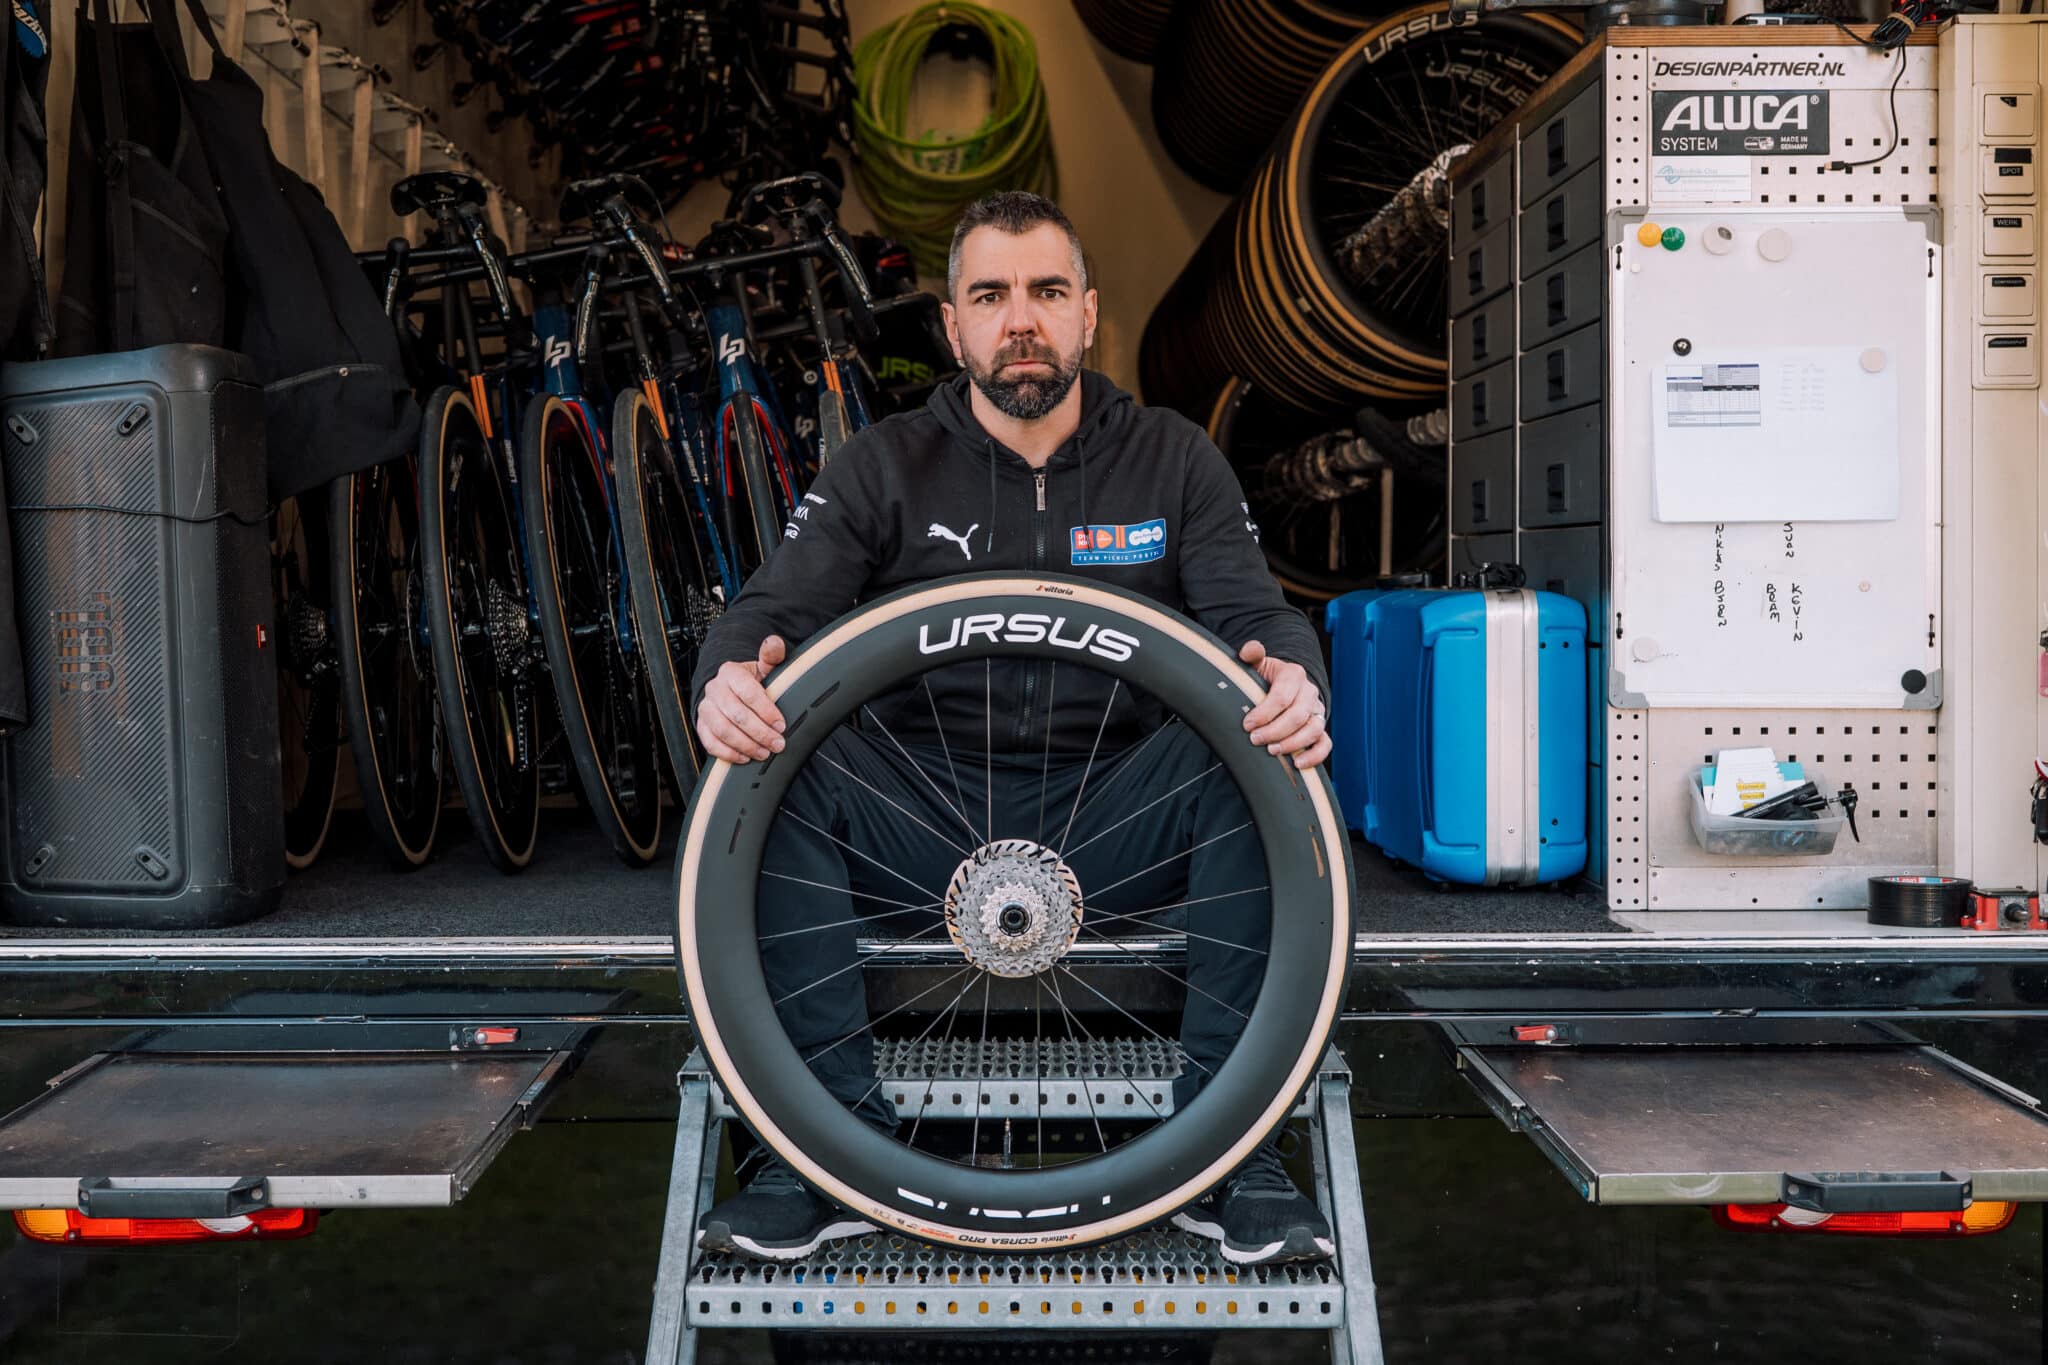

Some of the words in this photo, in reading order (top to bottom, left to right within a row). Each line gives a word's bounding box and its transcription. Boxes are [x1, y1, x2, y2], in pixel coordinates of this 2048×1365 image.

[1655, 62, 1847, 76] DESIGNPARTNER.NL
[1661, 137, 1718, 151] SYSTEM
[2001, 167, 2021, 175] SPOT
[1044, 586, 1073, 596] vittoria
[919, 613, 1141, 662] URSUS
[53, 591, 115, 696] JBL
[958, 1234, 986, 1244] PRO
[991, 1237, 1038, 1245] CORSA
[1040, 1234, 1070, 1243] vittoria
